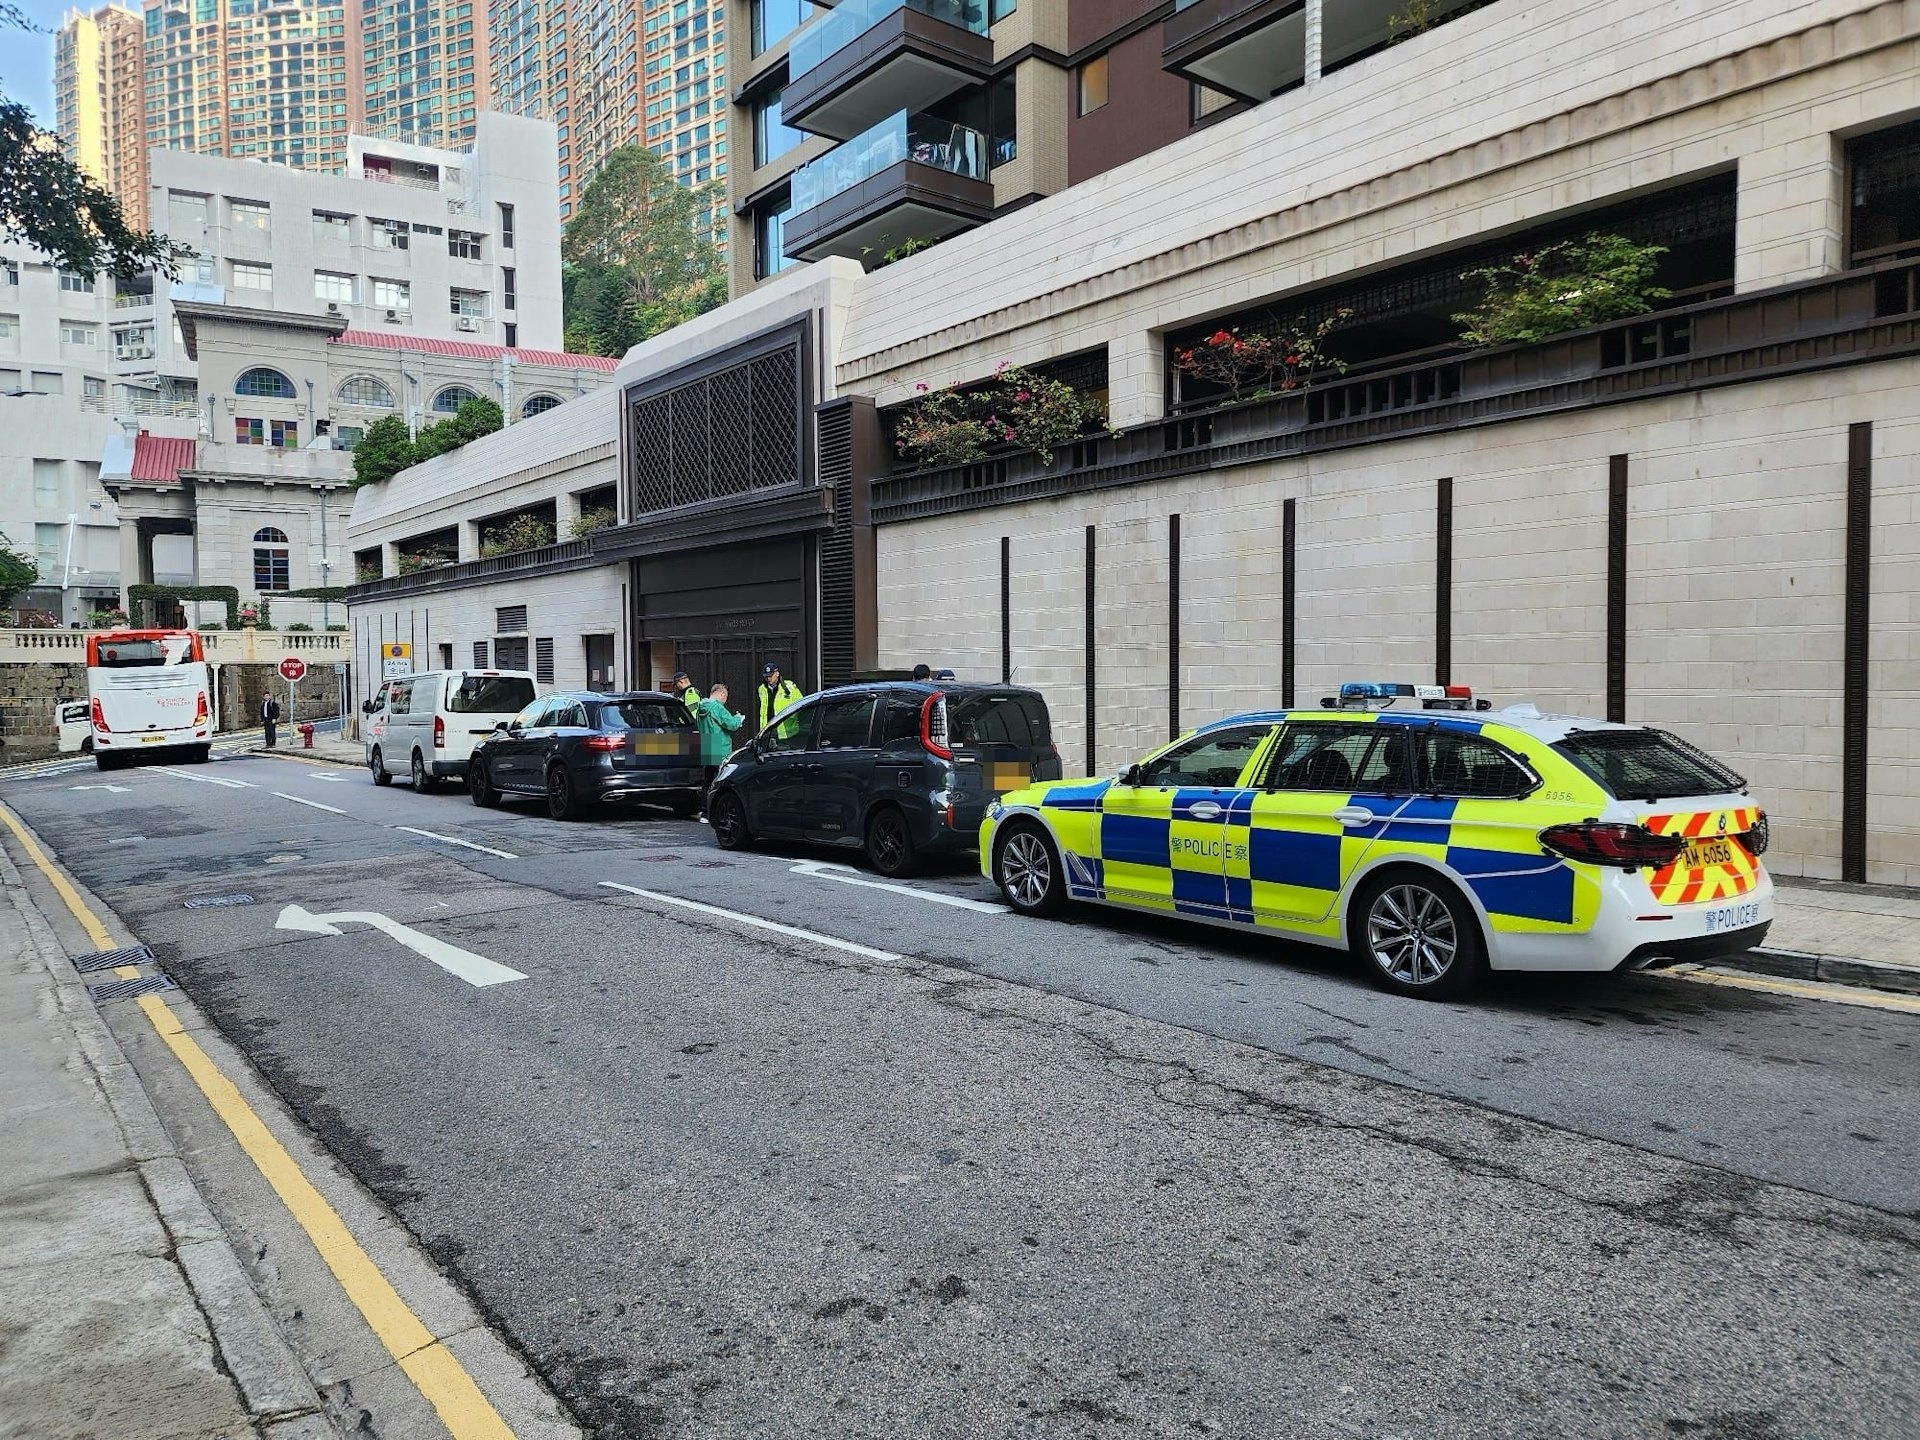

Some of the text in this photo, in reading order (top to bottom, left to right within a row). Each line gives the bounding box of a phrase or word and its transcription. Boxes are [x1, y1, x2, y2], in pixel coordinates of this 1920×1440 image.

[1545, 790, 1572, 801] 6056
[1684, 844, 1731, 867] AM 6056
